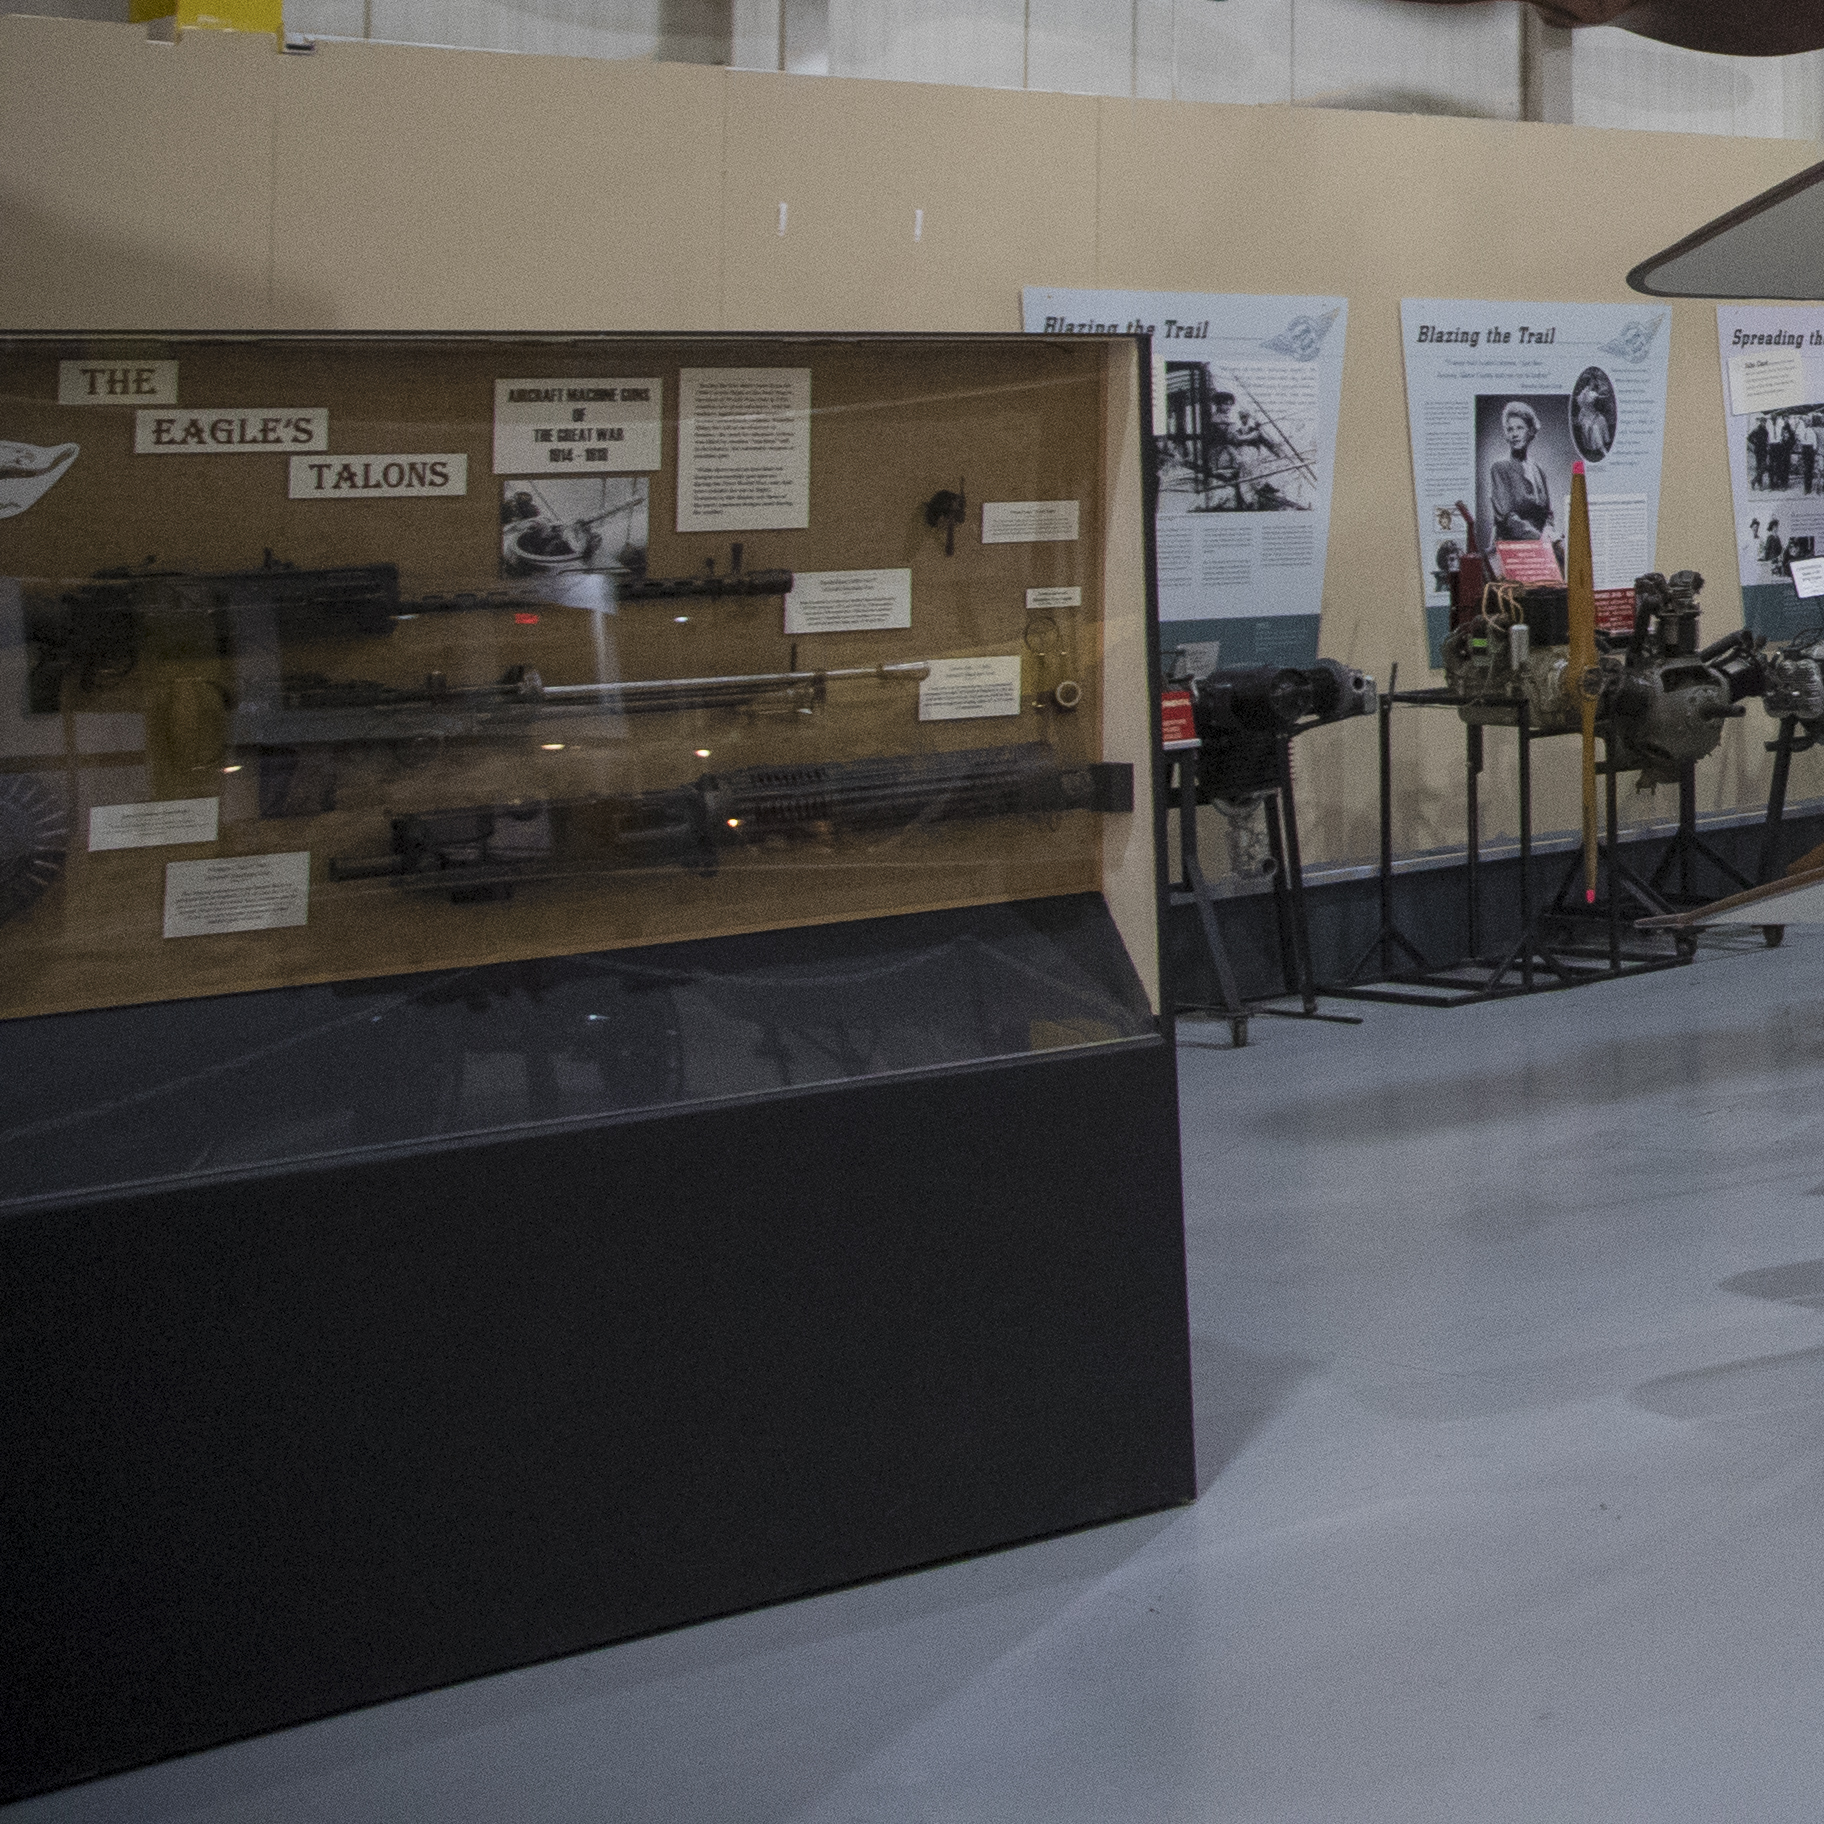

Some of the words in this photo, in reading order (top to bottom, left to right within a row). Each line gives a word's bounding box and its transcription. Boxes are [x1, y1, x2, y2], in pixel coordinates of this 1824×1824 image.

[1126, 319, 1156, 336] the
[1164, 319, 1210, 339] Trail
[1417, 325, 1481, 348] Blazing
[1486, 326, 1511, 345] the
[1518, 327, 1556, 345] Trail
[1731, 328, 1803, 349] Spreading
[81, 367, 157, 396] THE
[507, 387, 563, 402] AIRCRAFT
[566, 387, 618, 402] MACHINE
[620, 387, 651, 402] GUNS
[572, 407, 587, 422] OF
[151, 416, 314, 446] EAGLE'S
[533, 428, 553, 442] THE
[556, 428, 593, 442] GREAT
[595, 427, 624, 442] WAR
[549, 448, 574, 462] 1914
[585, 447, 609, 462] 1918
[309, 462, 451, 490] TALONS
